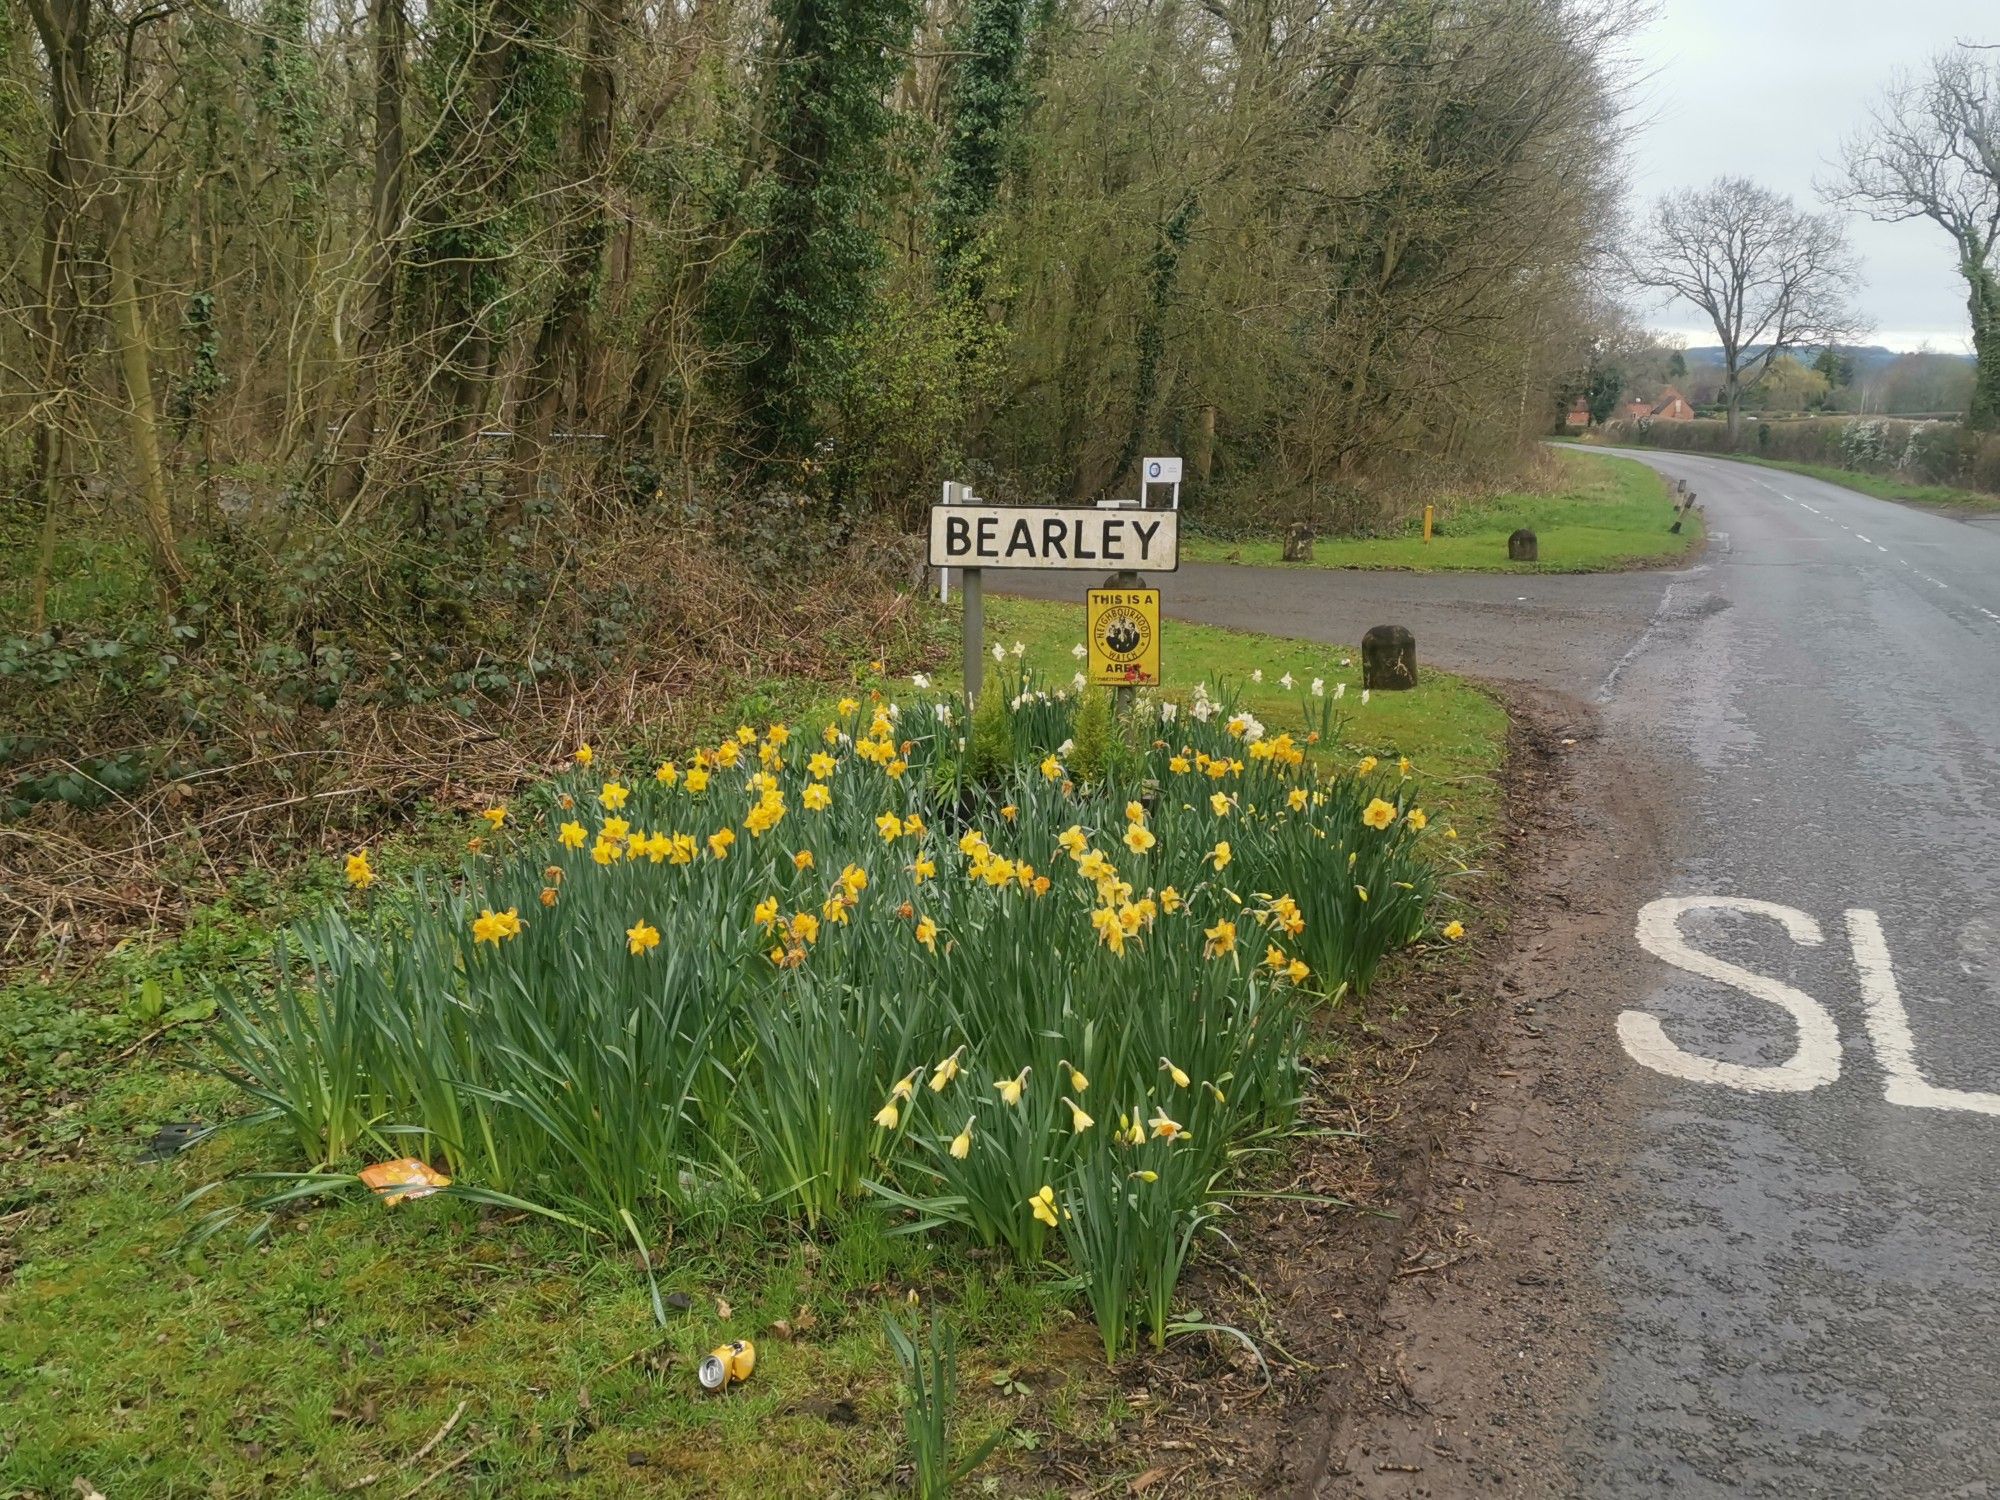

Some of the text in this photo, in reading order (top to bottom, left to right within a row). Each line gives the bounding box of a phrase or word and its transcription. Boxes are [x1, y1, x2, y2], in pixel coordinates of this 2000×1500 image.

[946, 516, 1161, 561] BEARLEY
[1092, 594, 1153, 605] THIS IS A
[1096, 608, 1149, 639] NEIGHBOURHOOD
[1109, 650, 1138, 661] WATCH
